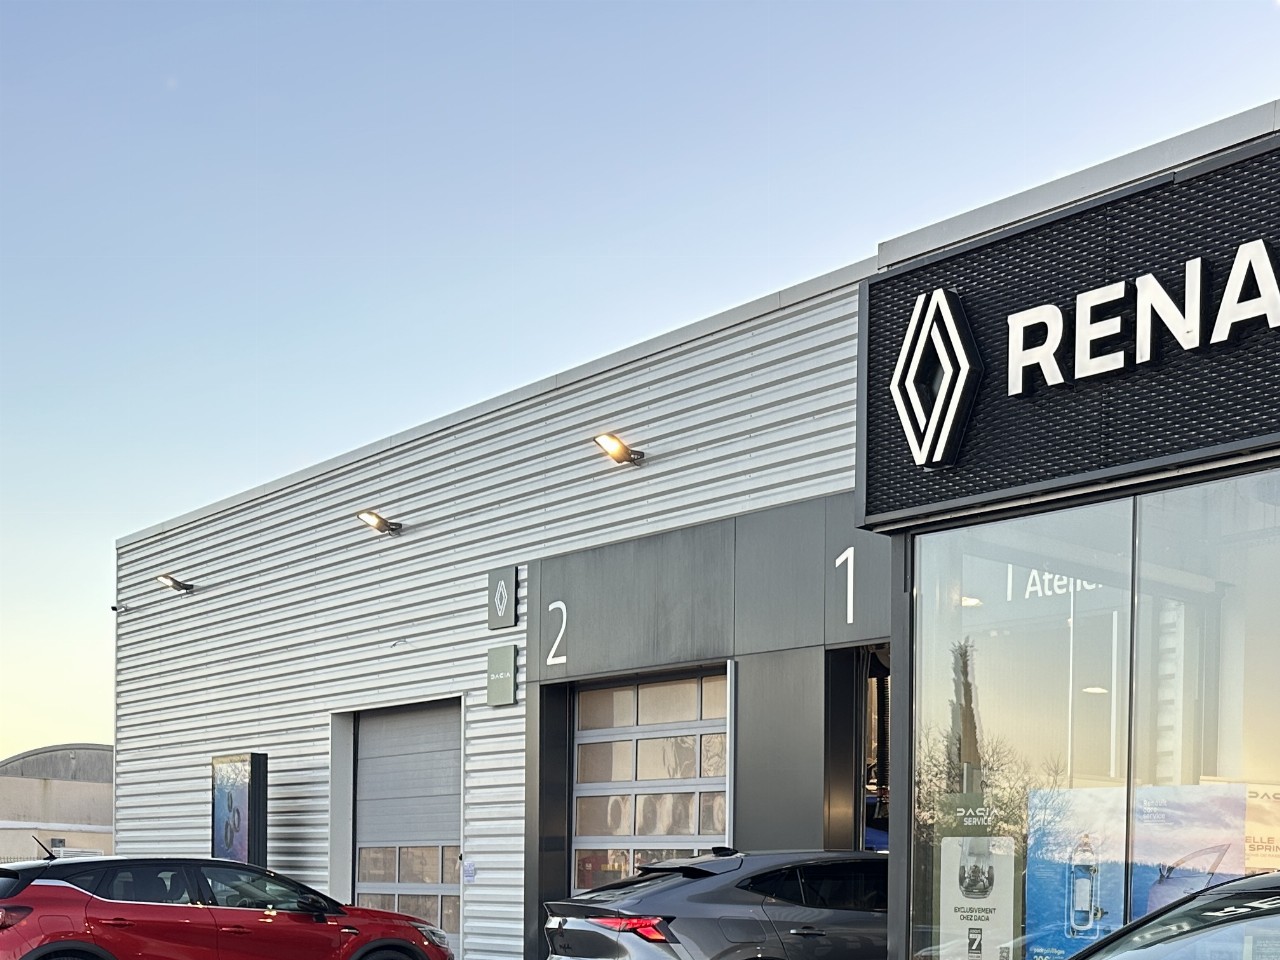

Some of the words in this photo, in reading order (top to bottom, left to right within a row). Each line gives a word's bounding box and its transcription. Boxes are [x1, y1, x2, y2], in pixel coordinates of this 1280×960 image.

[835, 546, 854, 625] 1
[546, 600, 568, 666] 2
[957, 807, 999, 816] DACIA
[963, 817, 992, 826] SERVICE
